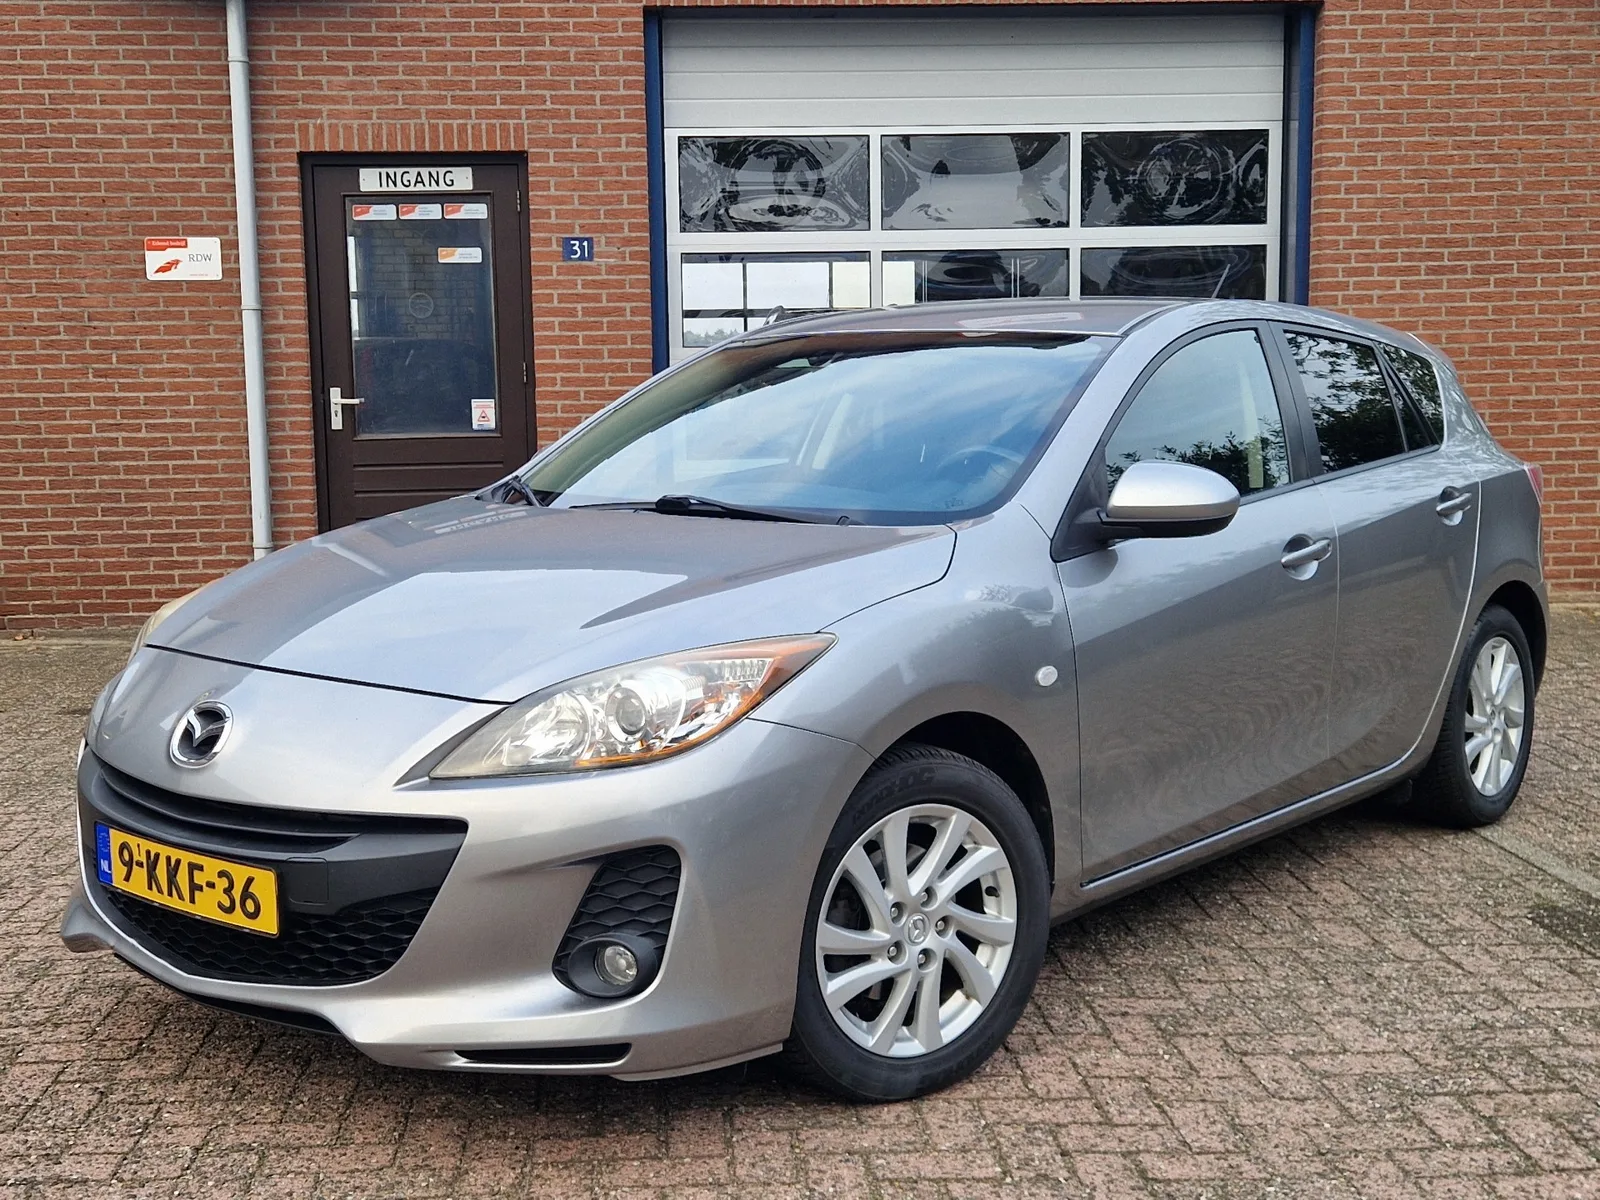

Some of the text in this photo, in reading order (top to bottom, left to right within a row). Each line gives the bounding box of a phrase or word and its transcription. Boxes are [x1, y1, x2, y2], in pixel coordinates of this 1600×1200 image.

[378, 170, 455, 188] INGANG
[188, 253, 212, 262] RDW
[570, 240, 588, 259] 31
[100, 858, 112, 874] NL
[118, 841, 262, 920] 9-KKF-36
